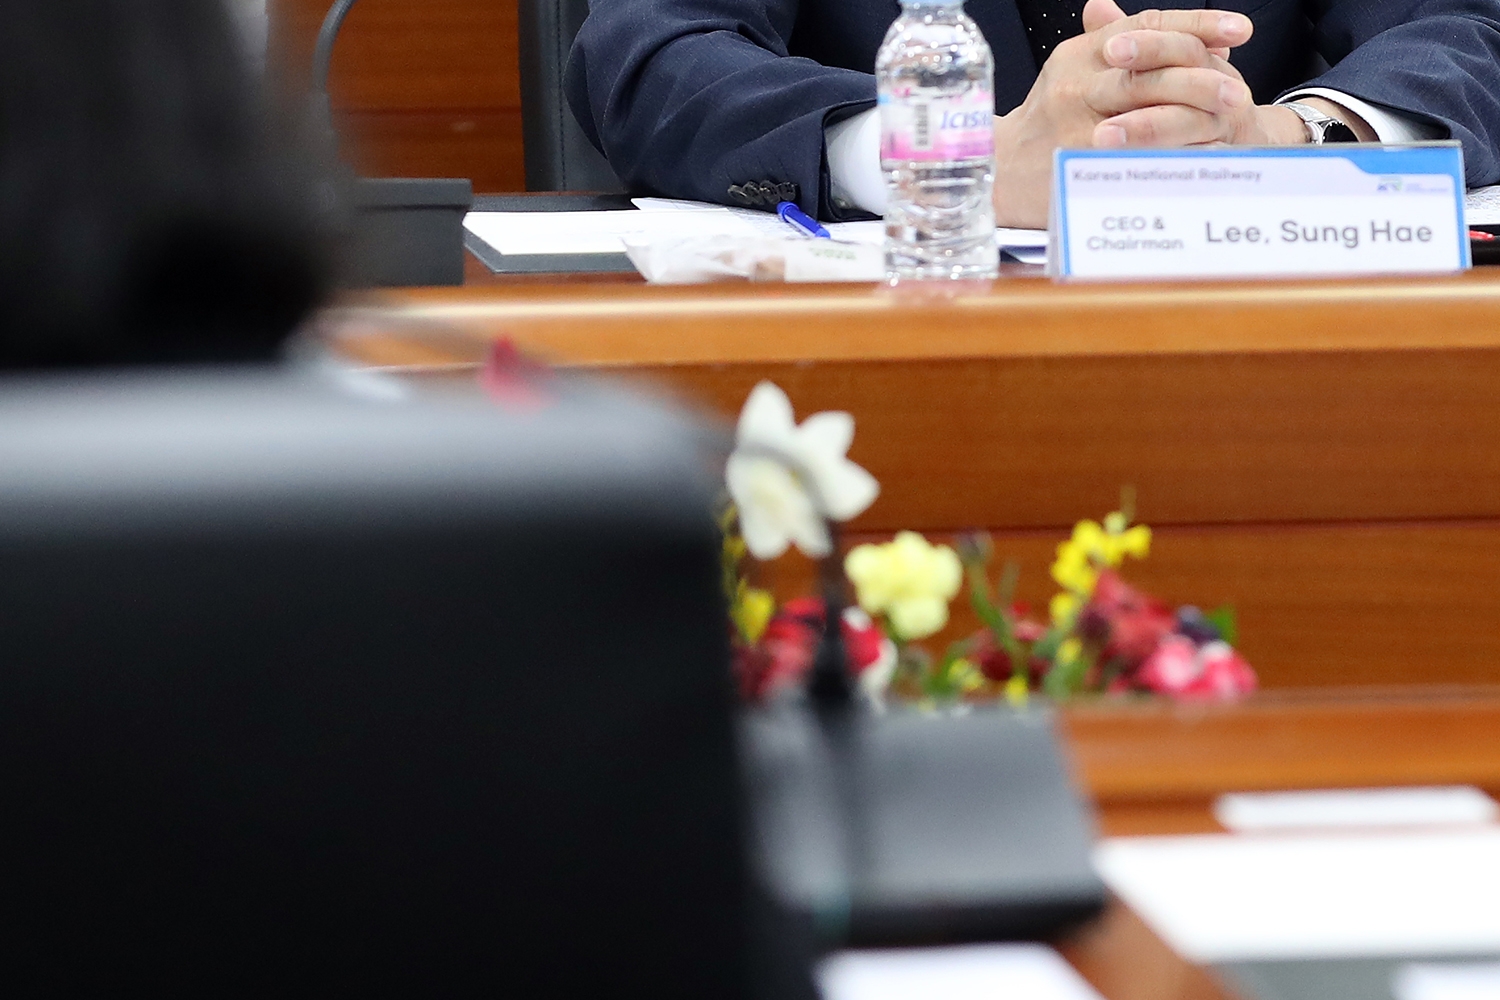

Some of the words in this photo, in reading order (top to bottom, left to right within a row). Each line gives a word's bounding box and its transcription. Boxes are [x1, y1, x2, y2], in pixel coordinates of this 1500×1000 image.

[1072, 168, 1122, 181] Korea
[1126, 168, 1195, 181] National
[1198, 167, 1262, 183] Railway
[1101, 215, 1147, 231] CEO
[1152, 215, 1166, 231] &
[1205, 220, 1270, 244] Lee,
[1280, 219, 1360, 249] Sung
[1370, 219, 1433, 242] Hae
[1086, 235, 1184, 251] Chairman
